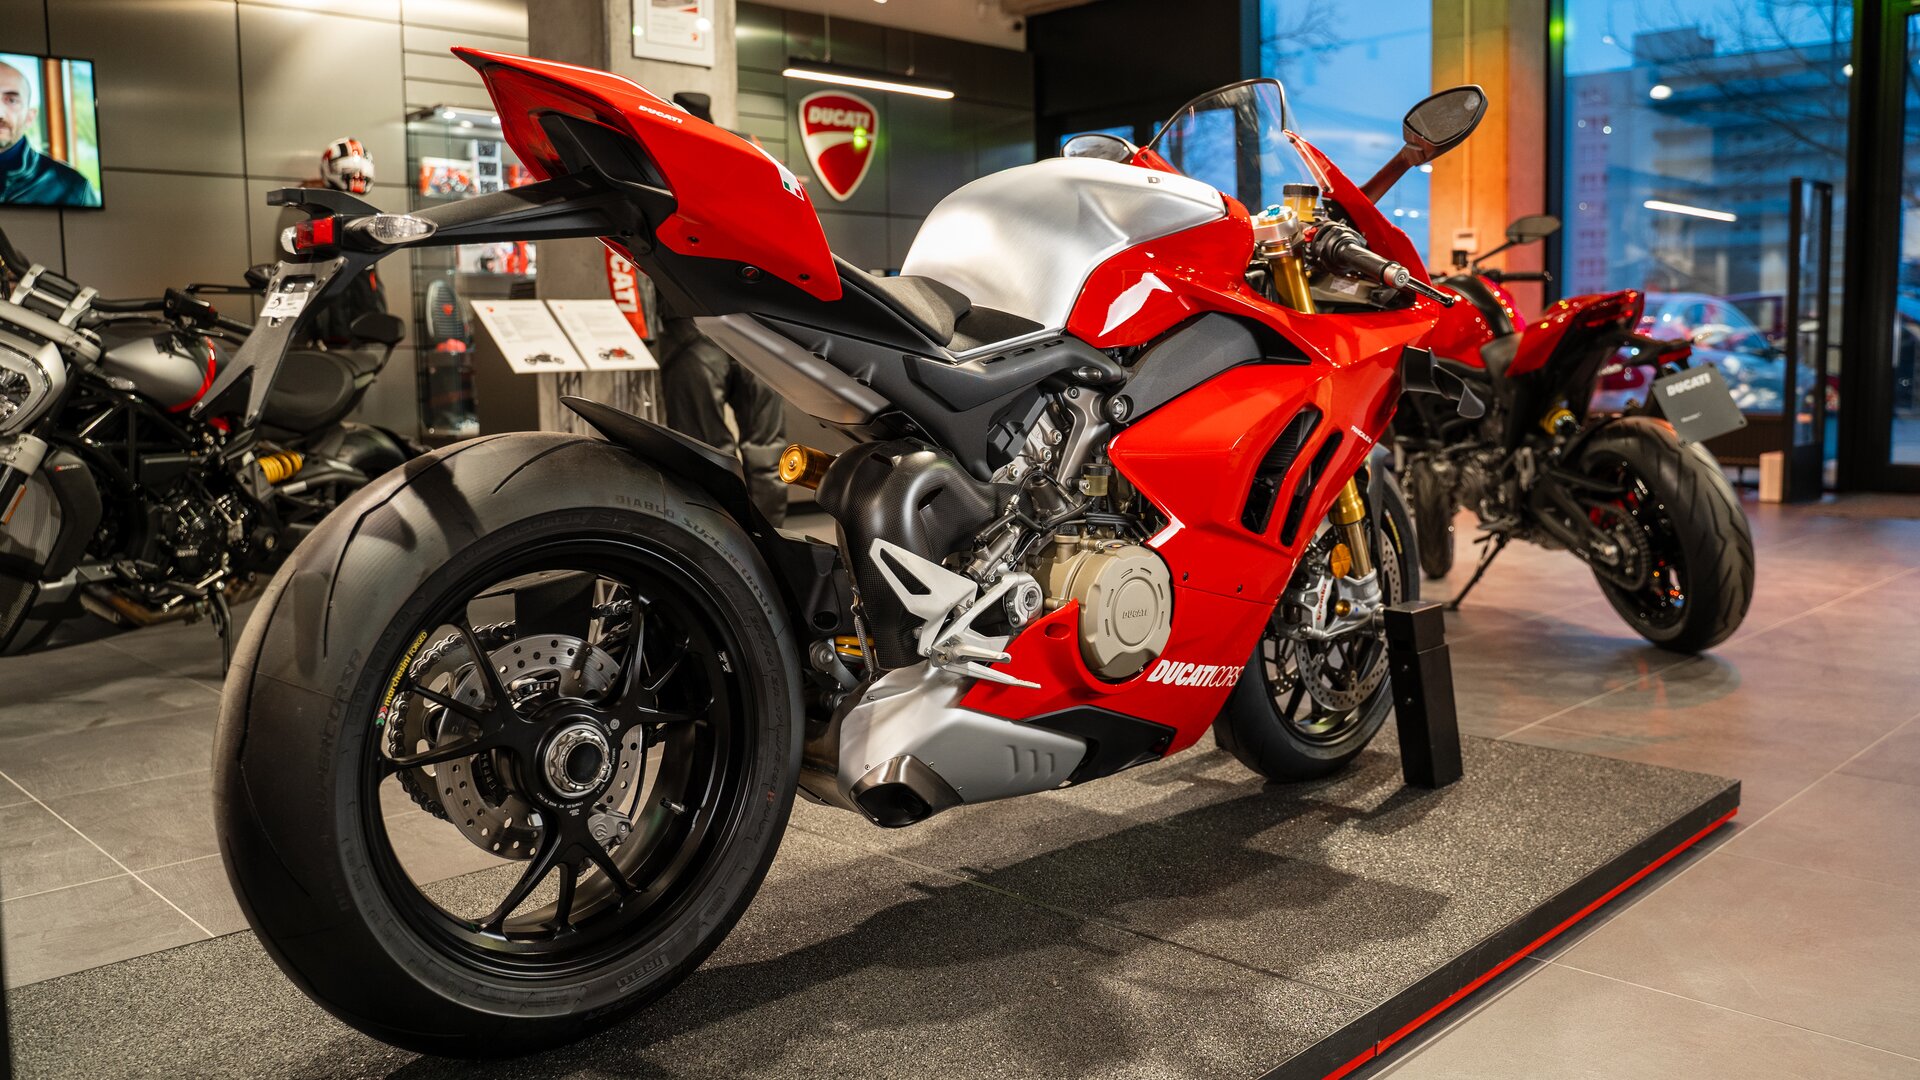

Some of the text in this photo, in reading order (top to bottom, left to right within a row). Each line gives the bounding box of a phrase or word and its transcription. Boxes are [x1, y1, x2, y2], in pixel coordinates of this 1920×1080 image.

[638, 105, 683, 124] DUCATI
[808, 106, 871, 129] DUCATI
[609, 248, 638, 313] CATI
[1666, 373, 1711, 397] DUCATI
[615, 494, 776, 616] DIABLO SUPERCORSA
[1122, 609, 1148, 619] DUCATI
[384, 631, 427, 707] marchesini FORGED
[615, 953, 670, 994] PIRELLI
